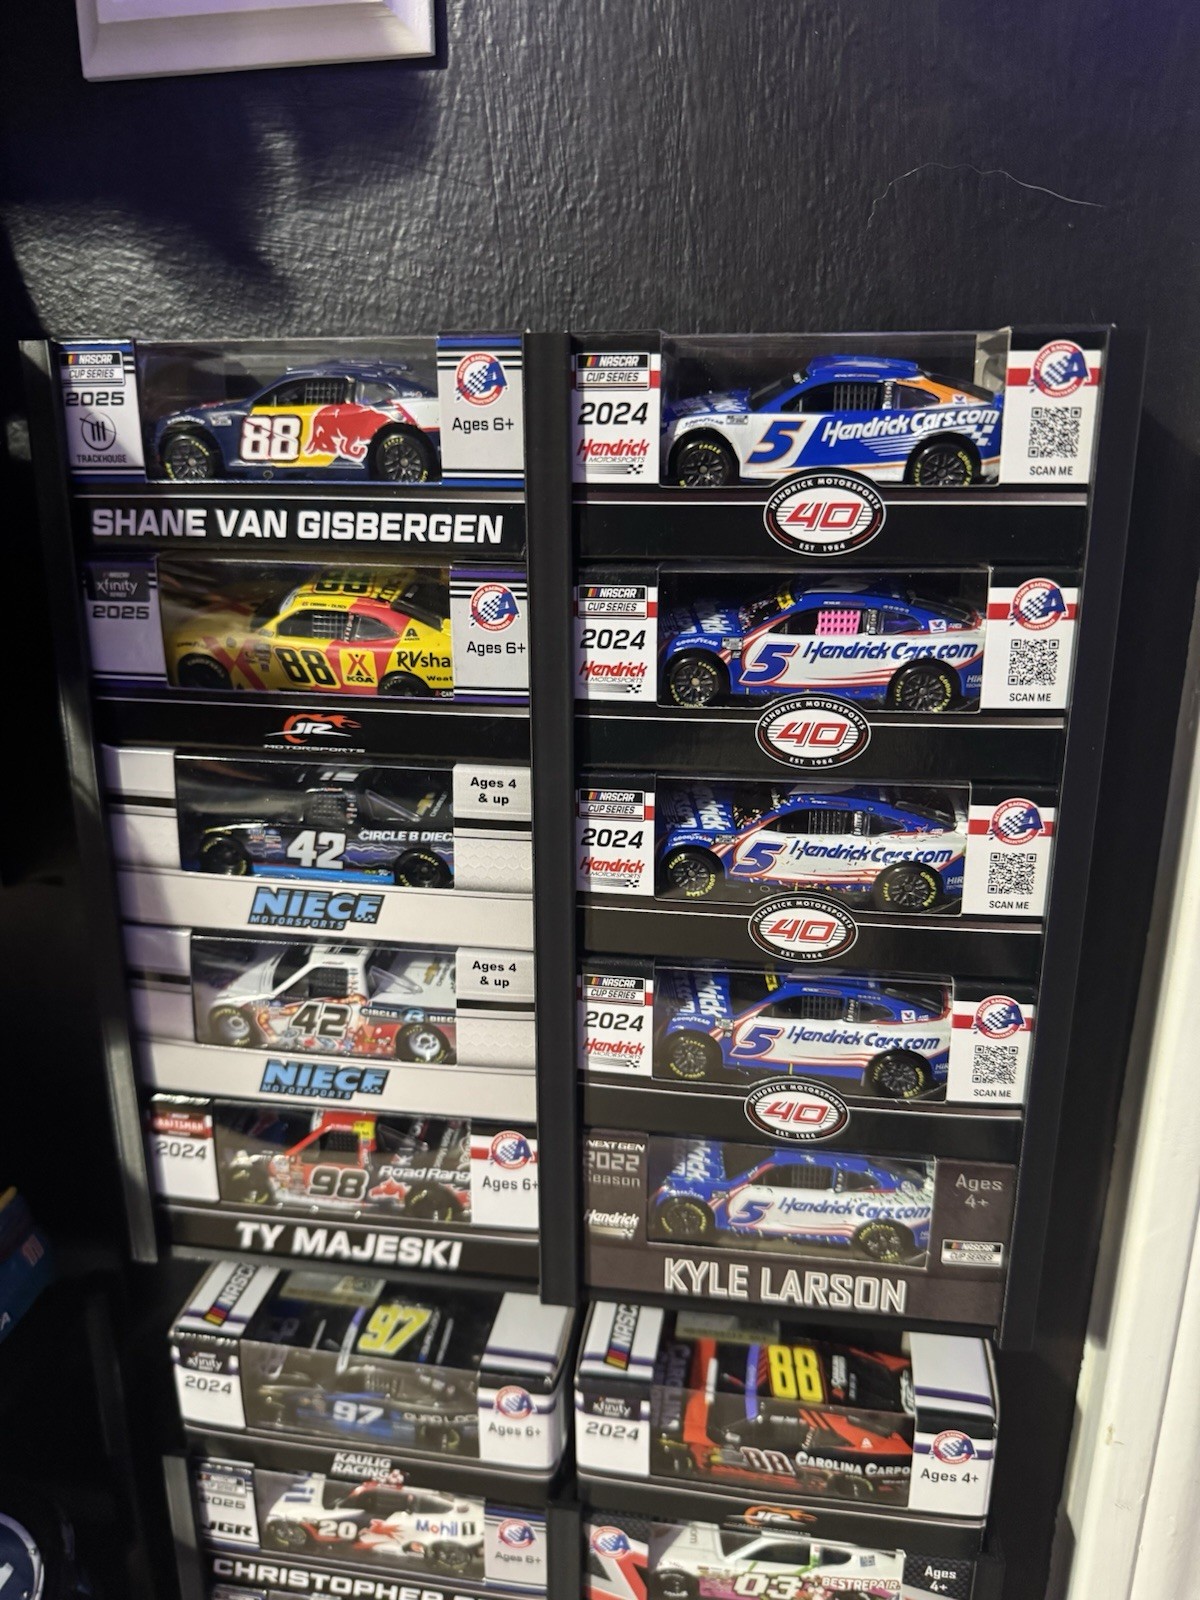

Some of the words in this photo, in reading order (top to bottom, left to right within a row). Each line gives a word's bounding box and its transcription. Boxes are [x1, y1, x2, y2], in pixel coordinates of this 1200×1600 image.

[78, 354, 113, 365] NASCAR
[598, 356, 639, 367] NASCAR
[69, 369, 85, 379] CUP
[86, 369, 115, 379] SERIES
[586, 372, 605, 382] CUP
[606, 372, 639, 382] SERIES
[65, 391, 125, 406] 2025
[577, 401, 649, 426] 2024
[452, 417, 489, 434] Ages
[493, 417, 515, 431] 6+
[241, 414, 301, 462] 88
[746, 419, 807, 465] 5
[577, 438, 650, 462] Hendrick
[77, 454, 128, 464] TRACKHOUSE
[1029, 465, 1056, 476] SCAN
[1058, 465, 1073, 476] ME
[769, 479, 814, 511] HENDRICK
[818, 478, 881, 511] MOTORSPORTS
[785, 502, 864, 532] 40
[92, 508, 207, 537] SHANE
[215, 509, 288, 539] VAN
[297, 510, 504, 544] GISBERGEN
[798, 542, 815, 552] EST
[822, 541, 846, 552] 1984
[97, 579, 138, 595] xfinity
[599, 587, 637, 598] NASCAR
[92, 605, 150, 620] 2025
[587, 602, 605, 611] CUP
[606, 602, 637, 612] SERIES
[579, 628, 646, 650] 2024
[466, 641, 502, 657] Ages
[506, 642, 526, 654] 6+
[274, 648, 338, 686] 88
[578, 660, 648, 682] Hendrick
[739, 642, 800, 684] 5
[347, 675, 375, 684] KOA
[1009, 692, 1035, 702] SCAN
[1037, 693, 1051, 702] ME
[761, 701, 802, 728] HENDRICK
[806, 700, 866, 731] MOTORSPORTS
[776, 722, 848, 747] 40
[264, 743, 366, 753] MOTORSPORTS
[789, 757, 805, 766] EST
[811, 757, 834, 766] 1984
[470, 777, 504, 790] Ages
[508, 779, 517, 788] 4
[478, 793, 488, 803] &
[492, 795, 509, 806] up
[599, 792, 635, 802] NASCAR
[588, 805, 605, 813] CUP
[606, 805, 635, 814] SERIES
[358, 830, 408, 841] CIRCLE
[409, 831, 419, 841] B
[421, 831, 454, 842] DIEC
[580, 828, 644, 849] 2024
[286, 830, 346, 869] 42
[580, 856, 645, 875] Hendrick
[730, 841, 788, 876] 5
[590, 871, 641, 879] MOTORSPORTS
[989, 900, 1013, 909] SCAN
[1015, 901, 1029, 910] ME
[251, 916, 345, 929] MOTORSPORTS
[753, 900, 793, 924] HENDRICK
[796, 900, 854, 930] MOTORSPORTS
[766, 918, 838, 943] 40
[780, 950, 795, 958] EST
[472, 960, 505, 974] Ages
[508, 963, 517, 972] 4
[479, 976, 489, 986] &
[494, 978, 510, 989] up
[601, 977, 636, 988] NASCAR
[590, 988, 606, 998] CUP
[607, 990, 636, 1000] SERIES
[290, 1001, 350, 1038] 42
[361, 1008, 398, 1018] CIRCLE
[583, 1011, 645, 1032] 2024
[583, 1038, 645, 1056] Hendrick
[729, 1024, 785, 1058] 5
[262, 1084, 351, 1099] MOTORSPORTS
[750, 1084, 787, 1105] HENDRICK
[789, 1084, 846, 1113] MOTORSPORTS
[973, 1089, 997, 1097] SCAN
[998, 1090, 1011, 1098] ME
[763, 1100, 830, 1124] 40
[155, 1141, 207, 1160] 2024
[586, 1139, 617, 1150] NEXT
[617, 1142, 645, 1153] GEN
[378, 1165, 427, 1179] Road
[309, 1165, 369, 1200] 98
[482, 1175, 518, 1191] Ages
[522, 1178, 538, 1190] 6+
[955, 1173, 1003, 1192] Ages
[964, 1194, 989, 1208] 4+
[584, 1209, 640, 1227] Hendrick
[728, 1200, 774, 1226] 5
[236, 1221, 286, 1251] TY
[292, 1226, 463, 1270] MAJESKI
[664, 1257, 748, 1298] KYLE
[761, 1267, 907, 1314] LARSON
[357, 1303, 433, 1352] 97
[768, 1344, 823, 1402] 88
[184, 1375, 232, 1394] 2024
[332, 1400, 384, 1424] 97
[488, 1422, 522, 1436] Ages
[525, 1425, 542, 1437] 6+
[585, 1421, 639, 1441] 2024
[333, 1452, 392, 1469] KAULIG
[795, 1450, 862, 1474] CAROLINA
[331, 1463, 390, 1478] RACING
[920, 1468, 957, 1482] Ages
[961, 1473, 979, 1483] 4+
[317, 1520, 357, 1539] 20
[415, 1519, 459, 1537] Mobil
[494, 1551, 523, 1564] Ages
[924, 1565, 957, 1579] Ages
[733, 1572, 802, 1599] 03
[930, 1582, 948, 1592] 4+
